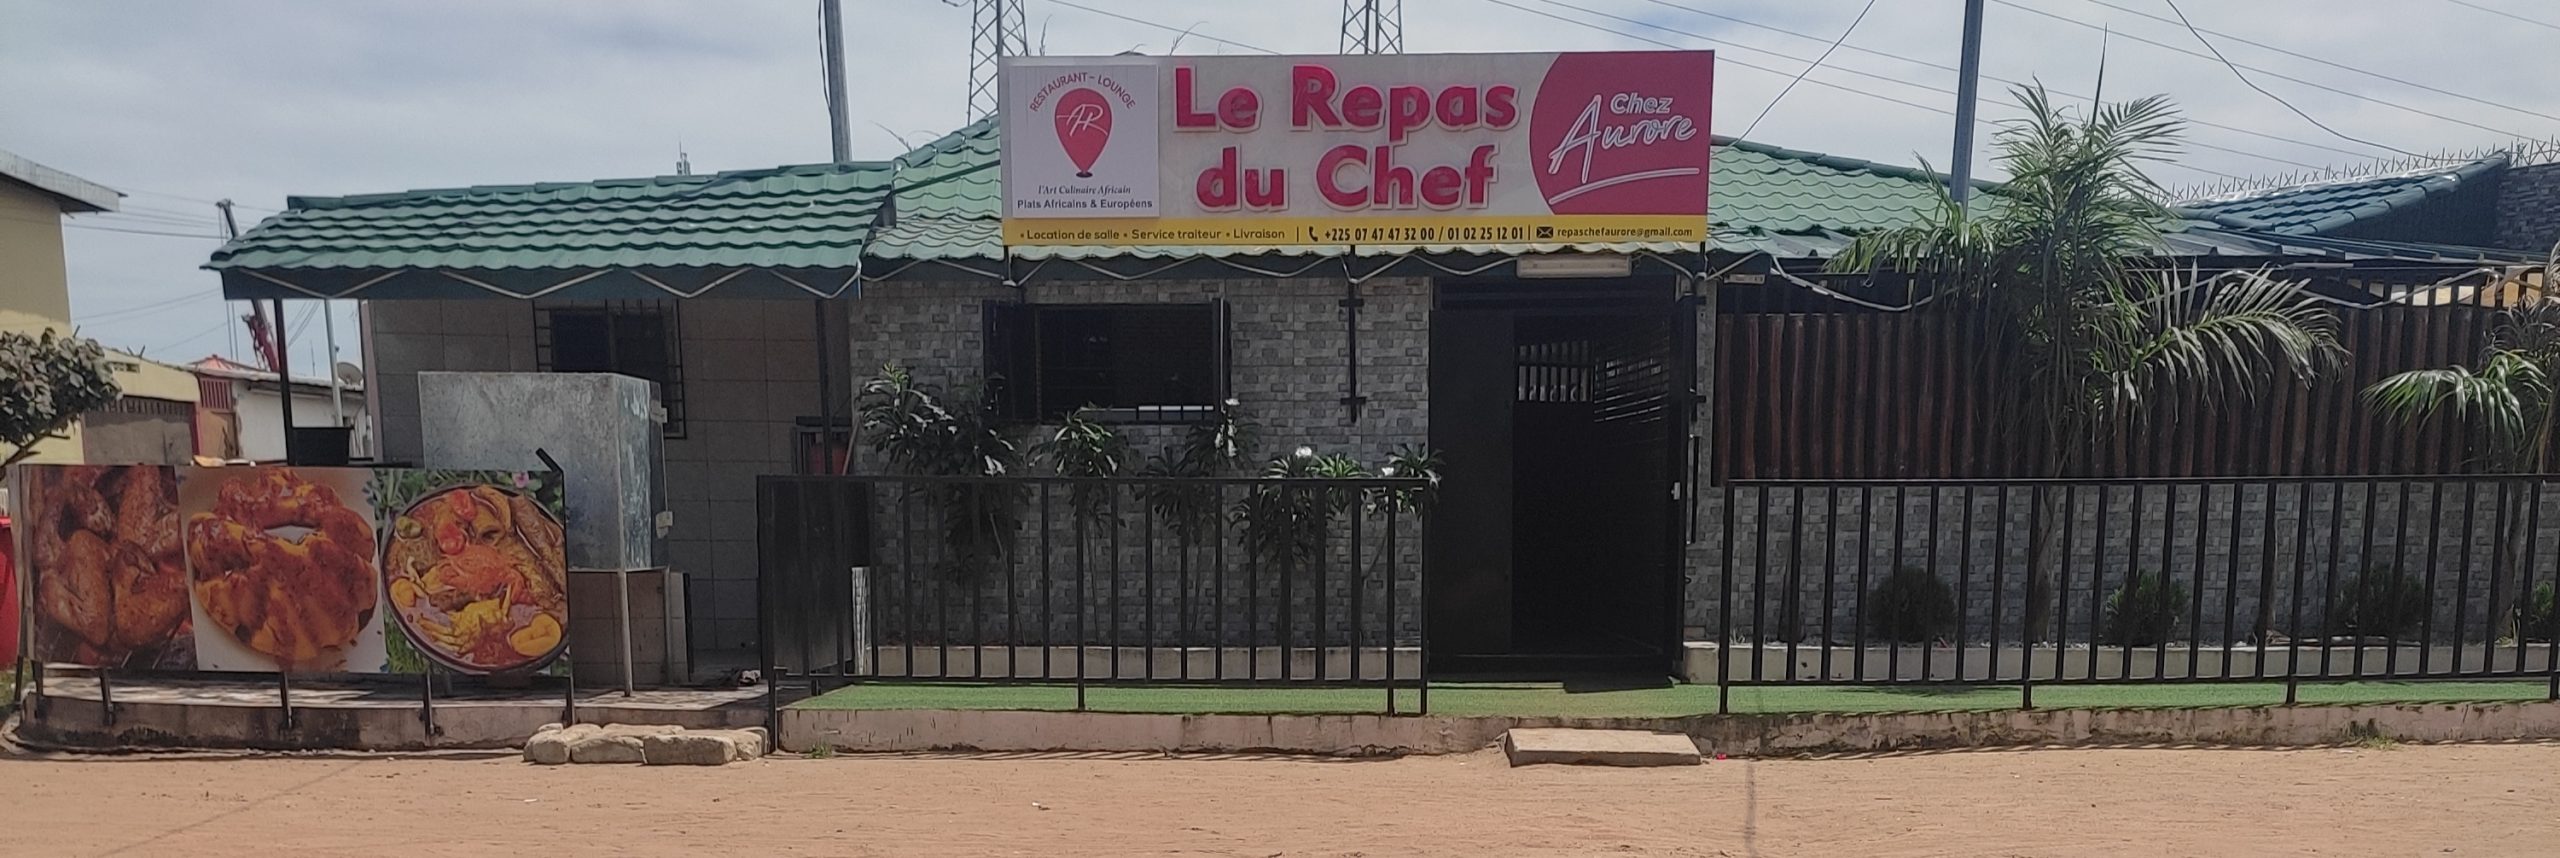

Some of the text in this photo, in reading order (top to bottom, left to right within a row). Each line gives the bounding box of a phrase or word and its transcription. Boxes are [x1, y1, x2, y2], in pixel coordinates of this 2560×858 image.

[1030, 72, 1088, 112] RESTAURANT
[1098, 75, 1136, 110] LOUNGE
[1174, 65, 1518, 143] Le Repas
[1610, 93, 1673, 114] Chez
[1549, 95, 1697, 183] Aurore
[1196, 144, 1496, 209] du Chef
[1058, 185, 1097, 195] Culinaire
[1098, 185, 1131, 196] Africain
[1017, 199, 1153, 210] Plats Africains & Européens
[1026, 229, 1285, 240] Location de salle Service traiteur Livraison
[1324, 228, 1350, 241] +225
[1355, 228, 1367, 241] 07
[1371, 228, 1384, 241] 47
[1388, 228, 1400, 241] 47
[1404, 228, 1416, 241] 32
[1420, 228, 1435, 240] 00
[1448, 227, 1459, 240] 01
[1463, 227, 1475, 240] 02
[1480, 227, 1492, 240] 25
[1497, 227, 1508, 240] 12
[1511, 227, 1523, 240] 01
[1557, 227, 1693, 238] repaschefaurore@gmail.com
